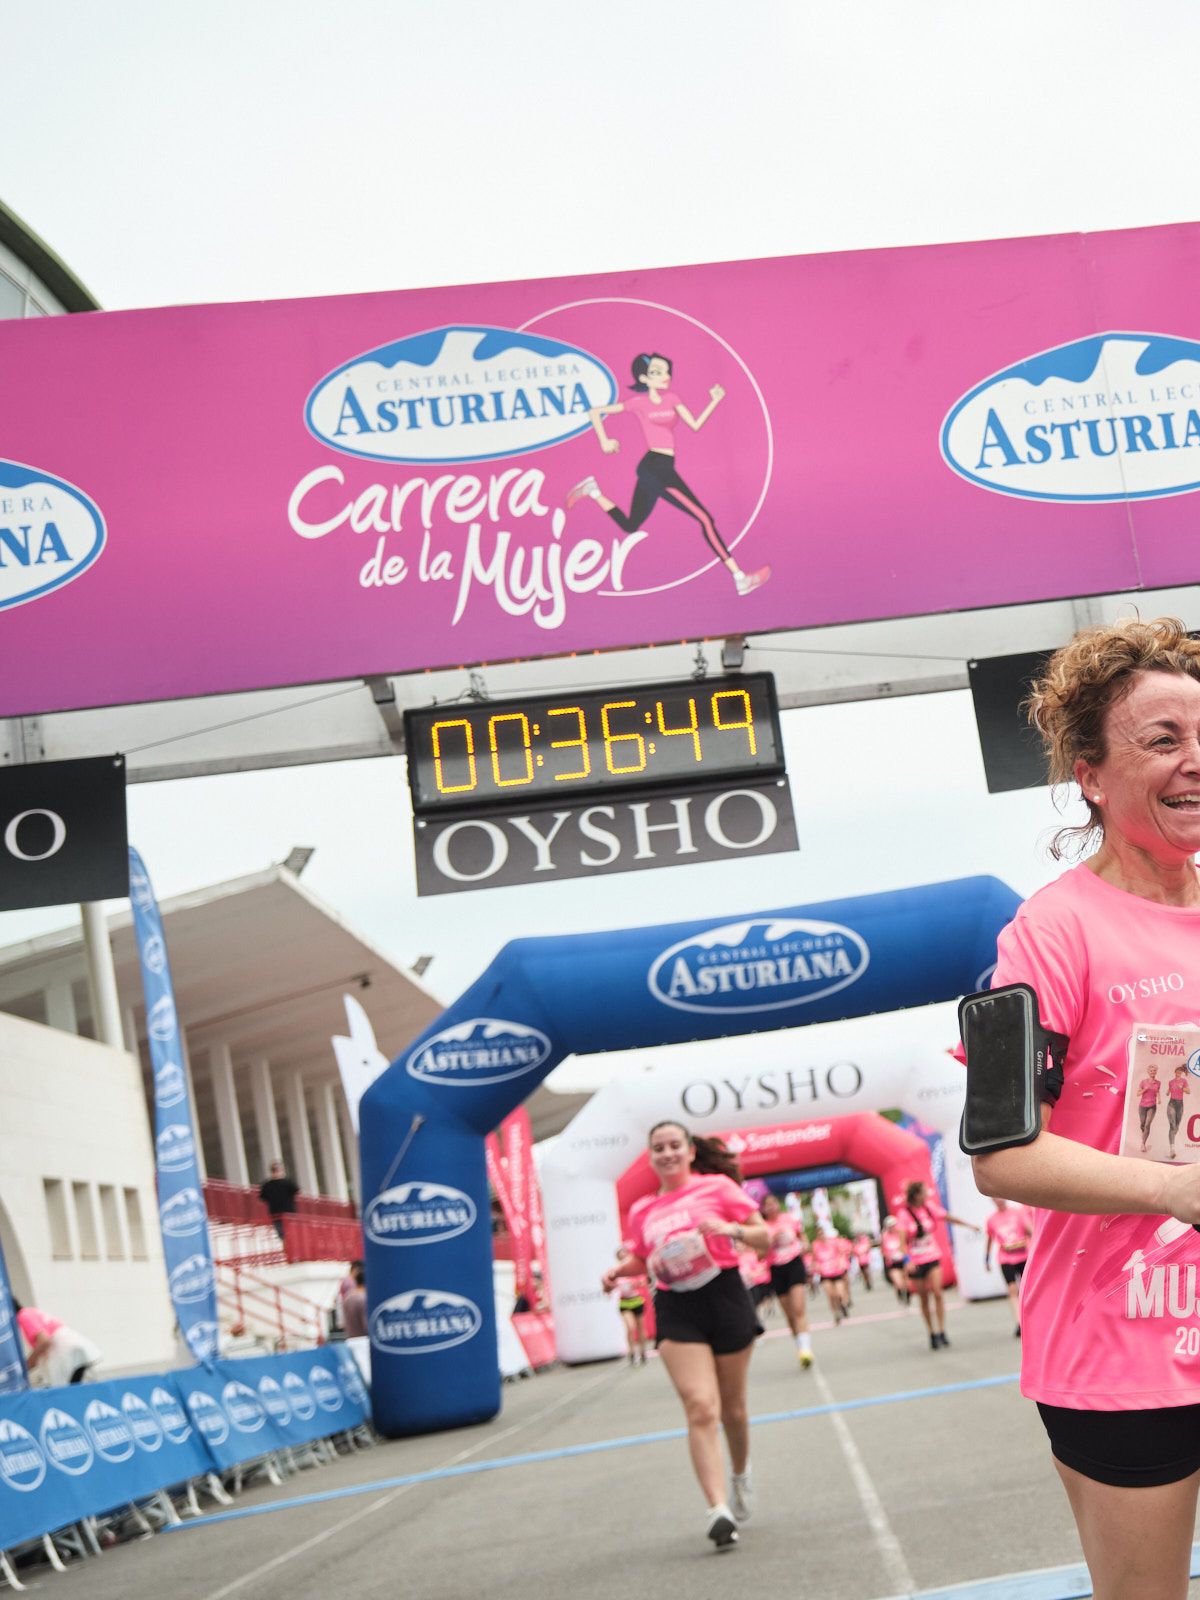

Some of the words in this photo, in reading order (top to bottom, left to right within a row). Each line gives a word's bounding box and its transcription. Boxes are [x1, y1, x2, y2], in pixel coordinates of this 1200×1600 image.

[376, 370, 473, 393] CENTRAL
[484, 362, 582, 385] LECHERA
[332, 380, 595, 437] ASTURIANA
[1023, 390, 1138, 416] CENTRAL
[287, 465, 549, 539] Carrera
[359, 537, 409, 588] de
[418, 530, 453, 583] la
[452, 508, 648, 629] Mujer
[431, 690, 757, 793] 00:36:49
[432, 789, 778, 882] OYSHO
[667, 947, 856, 999] ASTURIANA
[1108, 972, 1184, 1004] OYSHO
[417, 1046, 540, 1073] ASTURIANA
[1150, 1044, 1185, 1056] SUMA
[681, 1059, 864, 1118] OYSHO
[745, 1122, 832, 1151] Santander
[370, 1205, 470, 1235] ASTURIANA
[374, 1312, 474, 1342] ASTURIANA
